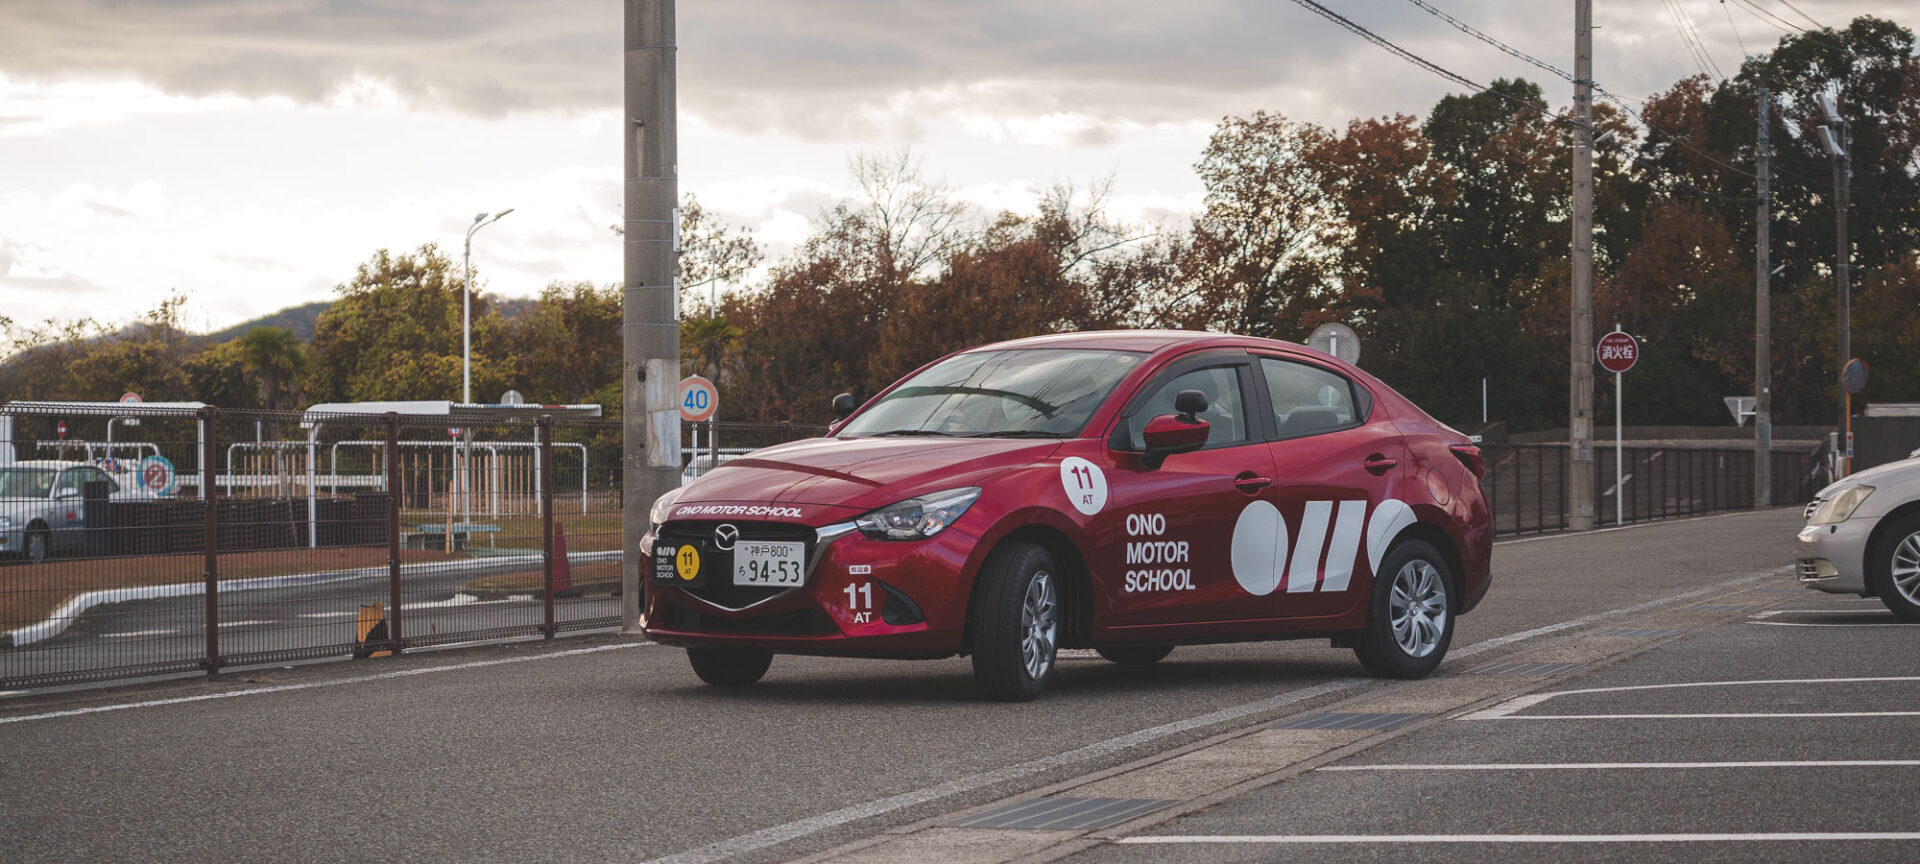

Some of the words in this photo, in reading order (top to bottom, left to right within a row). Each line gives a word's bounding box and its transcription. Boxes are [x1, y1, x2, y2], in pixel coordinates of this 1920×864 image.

[1602, 345, 1634, 359] 消火栓
[684, 390, 708, 409] 40
[1071, 465, 1094, 489] 11
[1082, 494, 1094, 505] AT
[676, 506, 701, 515] ONO
[700, 505, 747, 515] MOTOR
[745, 506, 803, 518] SCHOOL
[1126, 513, 1166, 536] ONO
[682, 552, 693, 566] 11
[1126, 541, 1189, 564] MOTOR
[749, 559, 800, 583] 94-53
[1124, 568, 1196, 592] SCHOOL
[843, 582, 872, 609] 11
[854, 611, 872, 624] AT
